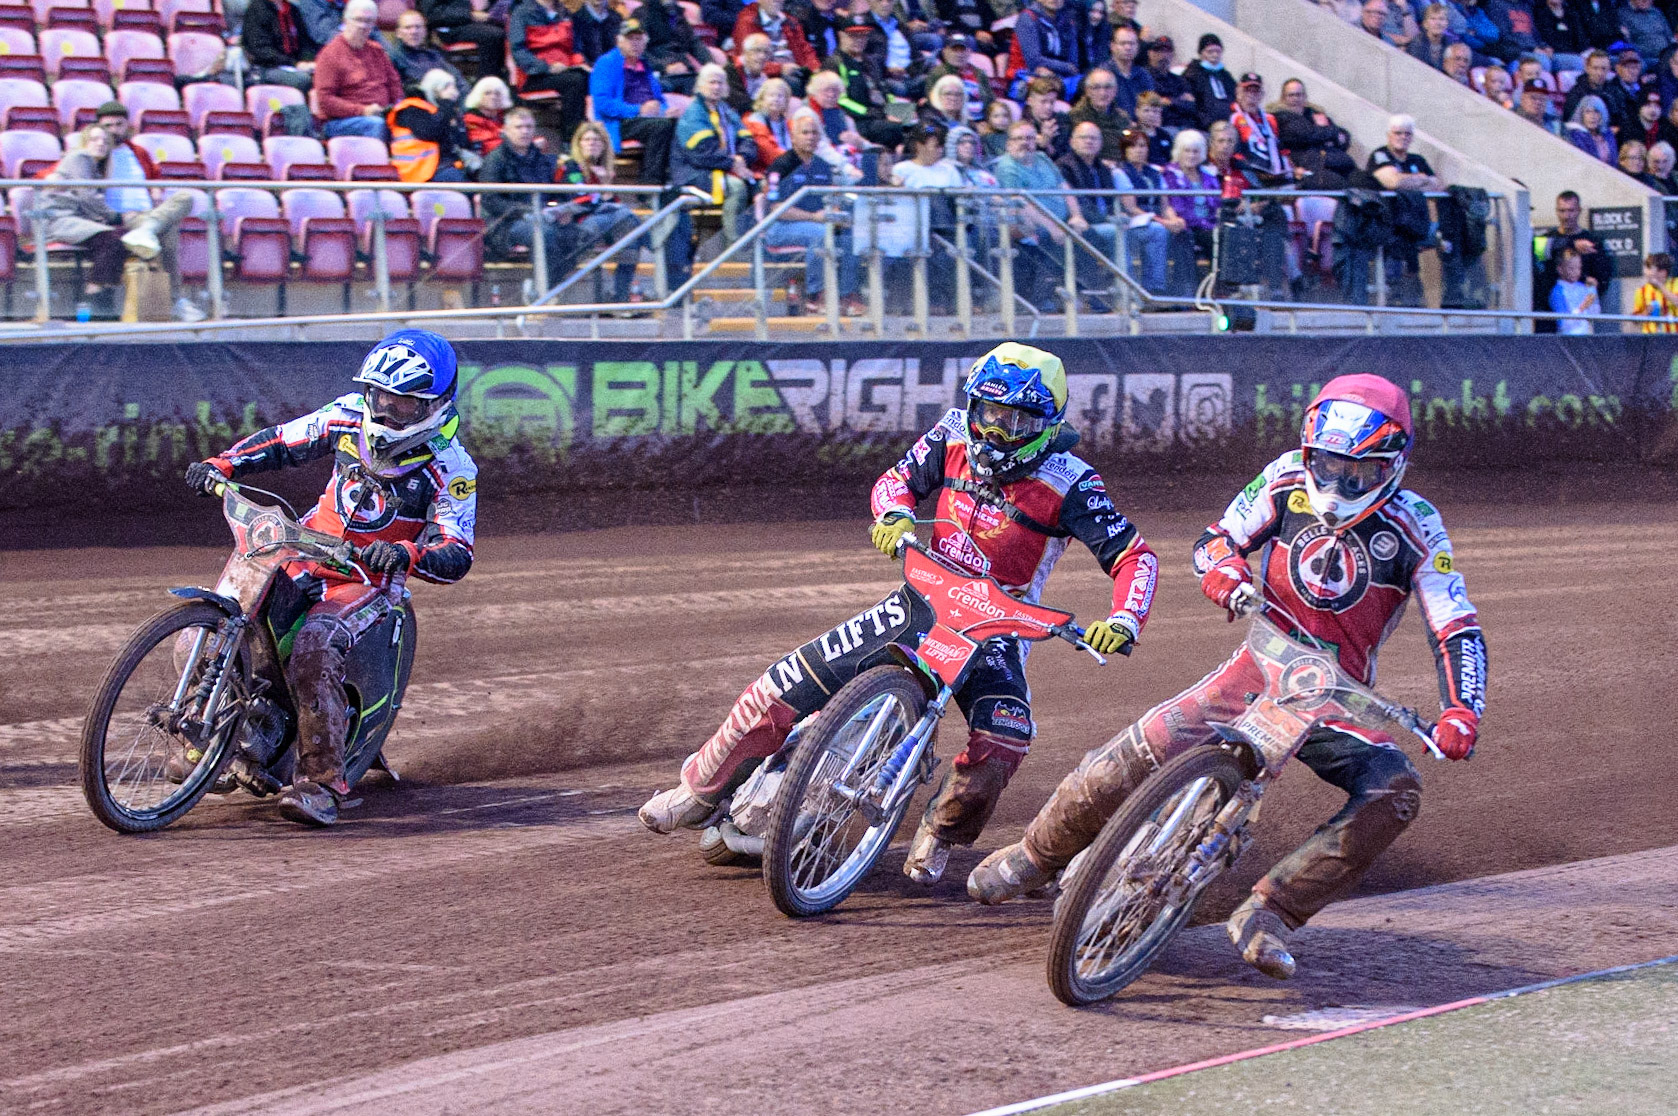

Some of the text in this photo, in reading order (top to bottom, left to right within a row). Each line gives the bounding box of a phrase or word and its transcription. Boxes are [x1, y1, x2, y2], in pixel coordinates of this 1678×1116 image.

[592, 357, 976, 436] BIKERIGH
[954, 499, 1000, 527] PANTHERS
[1296, 525, 1328, 548] BELLE
[938, 537, 992, 571] Crendon
[947, 586, 1006, 619] Crendon
[819, 594, 906, 662] LIFTS
[924, 637, 961, 658] MERIDIAN
[924, 646, 949, 662] LIFTS
[1242, 721, 1276, 746] PREMI
